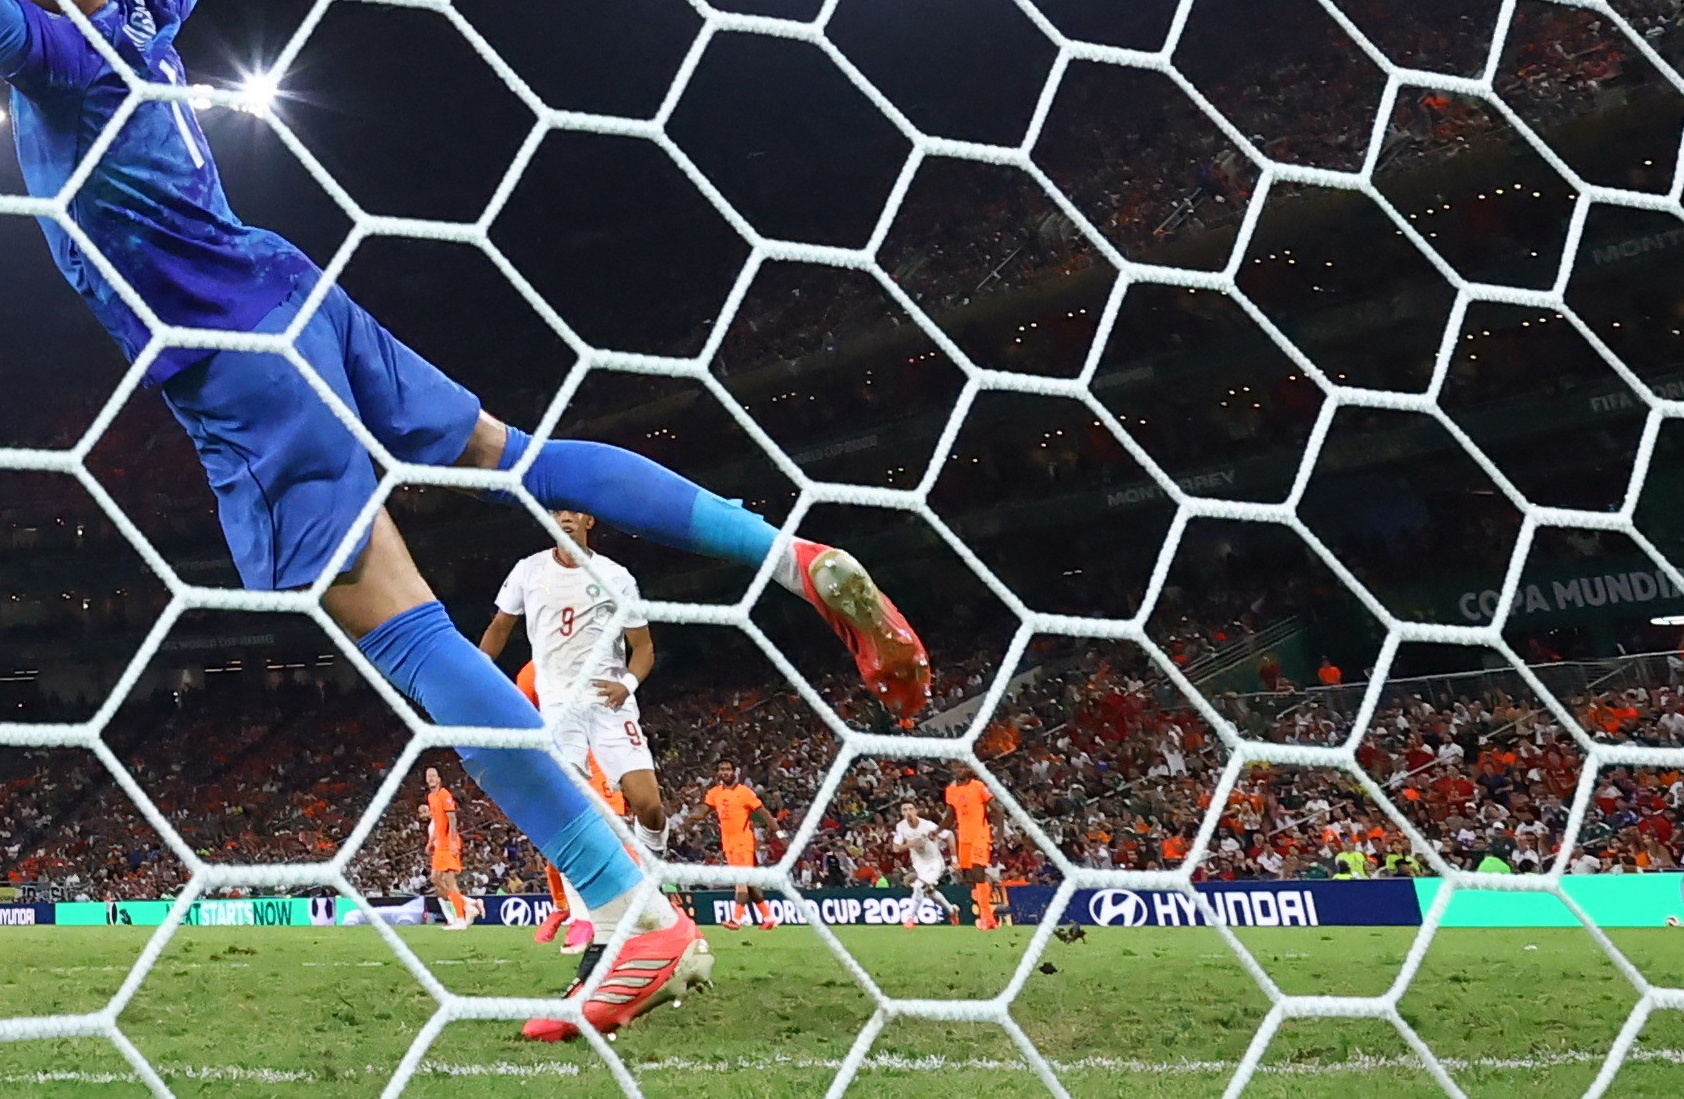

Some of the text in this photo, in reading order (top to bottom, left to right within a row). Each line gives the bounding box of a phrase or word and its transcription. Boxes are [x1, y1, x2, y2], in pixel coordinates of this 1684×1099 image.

[559, 607, 573, 637] 9
[624, 720, 642, 747] 9
[201, 903, 254, 926] STARTS
[253, 902, 292, 926] NOW
[822, 899, 861, 924] CUP
[1152, 890, 1319, 926] HYUNDAI
